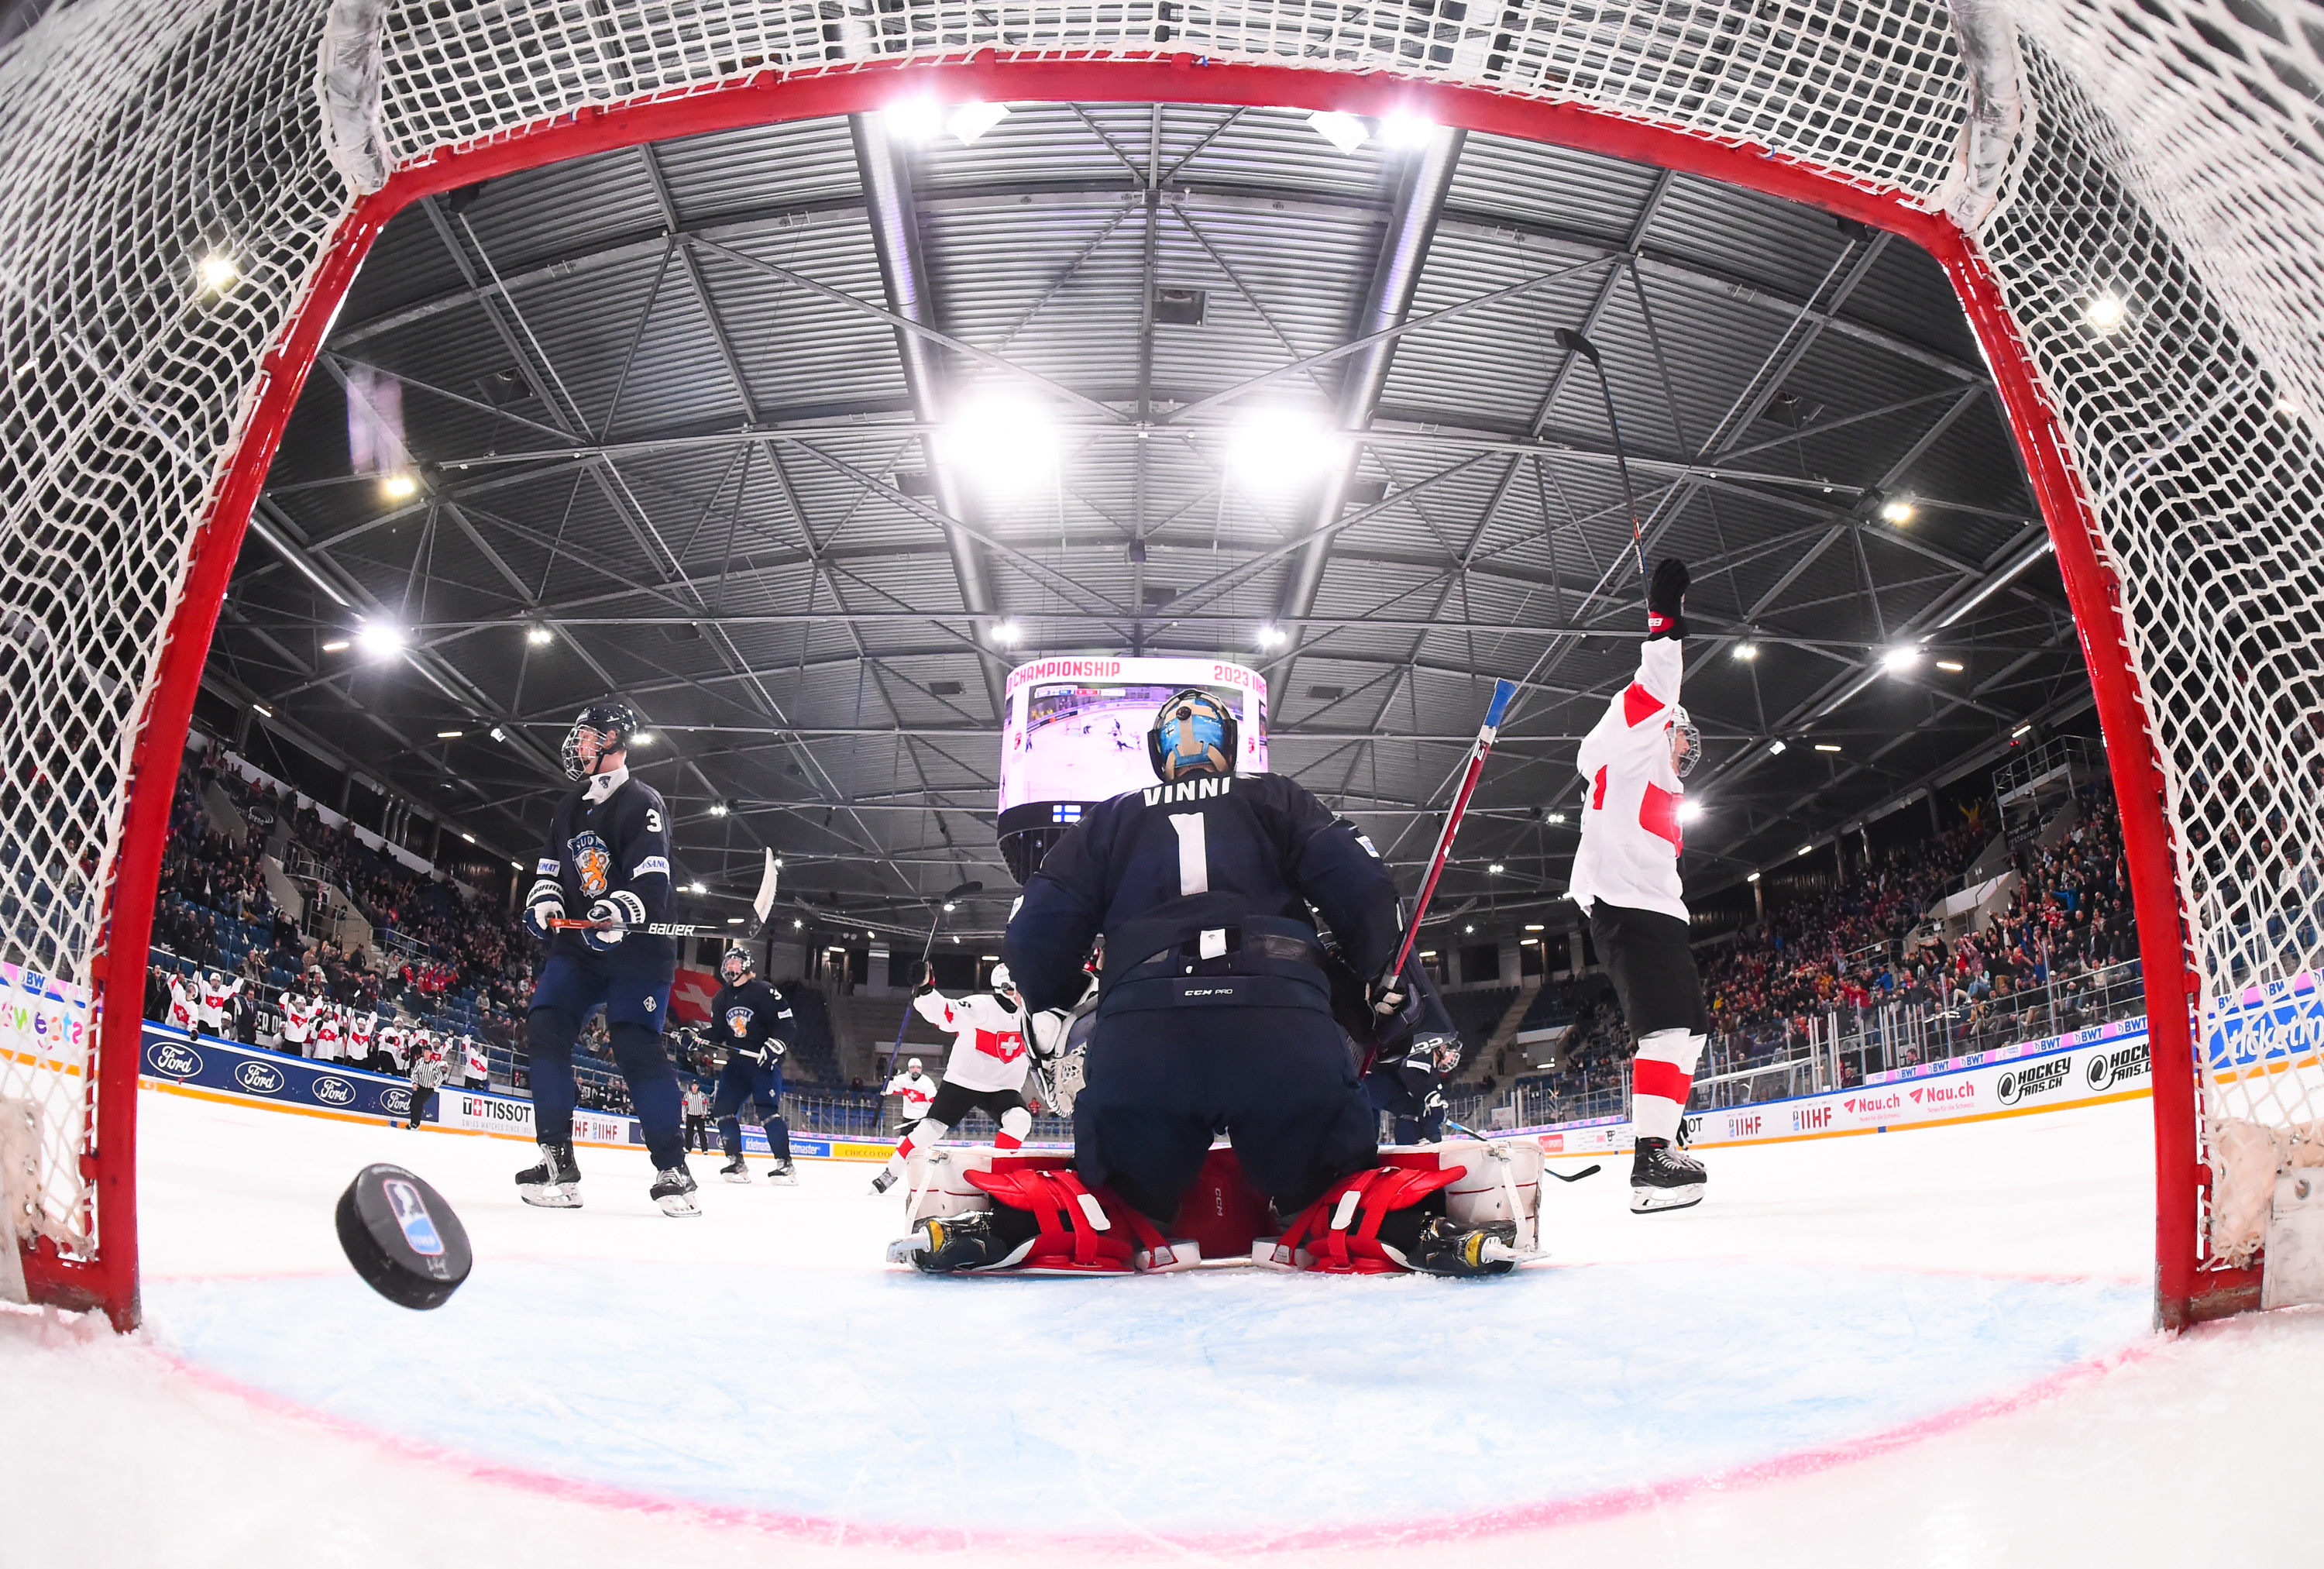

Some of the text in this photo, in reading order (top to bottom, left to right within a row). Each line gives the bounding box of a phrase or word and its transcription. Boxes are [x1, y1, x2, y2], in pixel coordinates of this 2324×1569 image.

[1013, 661, 1120, 686] CHAMPIONSHIP
[1214, 665, 1249, 687] 2023
[1143, 776, 1231, 807] VINNI
[645, 807, 662, 833] 3
[1168, 811, 1209, 896] 1
[26, 971, 48, 989] BW
[2269, 978, 2291, 996] BW
[2081, 1027, 2102, 1042] BWT
[2125, 1017, 2146, 1032] BWT
[2040, 1037, 2060, 1051] BWT
[157, 1045, 194, 1073] Ford
[1933, 1061, 1950, 1072] BWT
[1967, 1054, 1985, 1066] BWT
[244, 1064, 276, 1089] Ford
[1901, 1068, 1917, 1078] BWT
[2018, 1056, 2071, 1085] HOCKEY
[320, 1079, 348, 1102] Ford
[387, 1091, 411, 1111] Ford
[1927, 1081, 1975, 1103] Nau.ch
[484, 1100, 531, 1123] TISSOT
[1858, 1093, 1900, 1113] Nau.ch
[1736, 1116, 1762, 1136] IIHF
[1800, 1106, 1832, 1130] IIHF
[598, 1123, 617, 1141] IIHF
[1215, 1187, 1223, 1216] CCM
